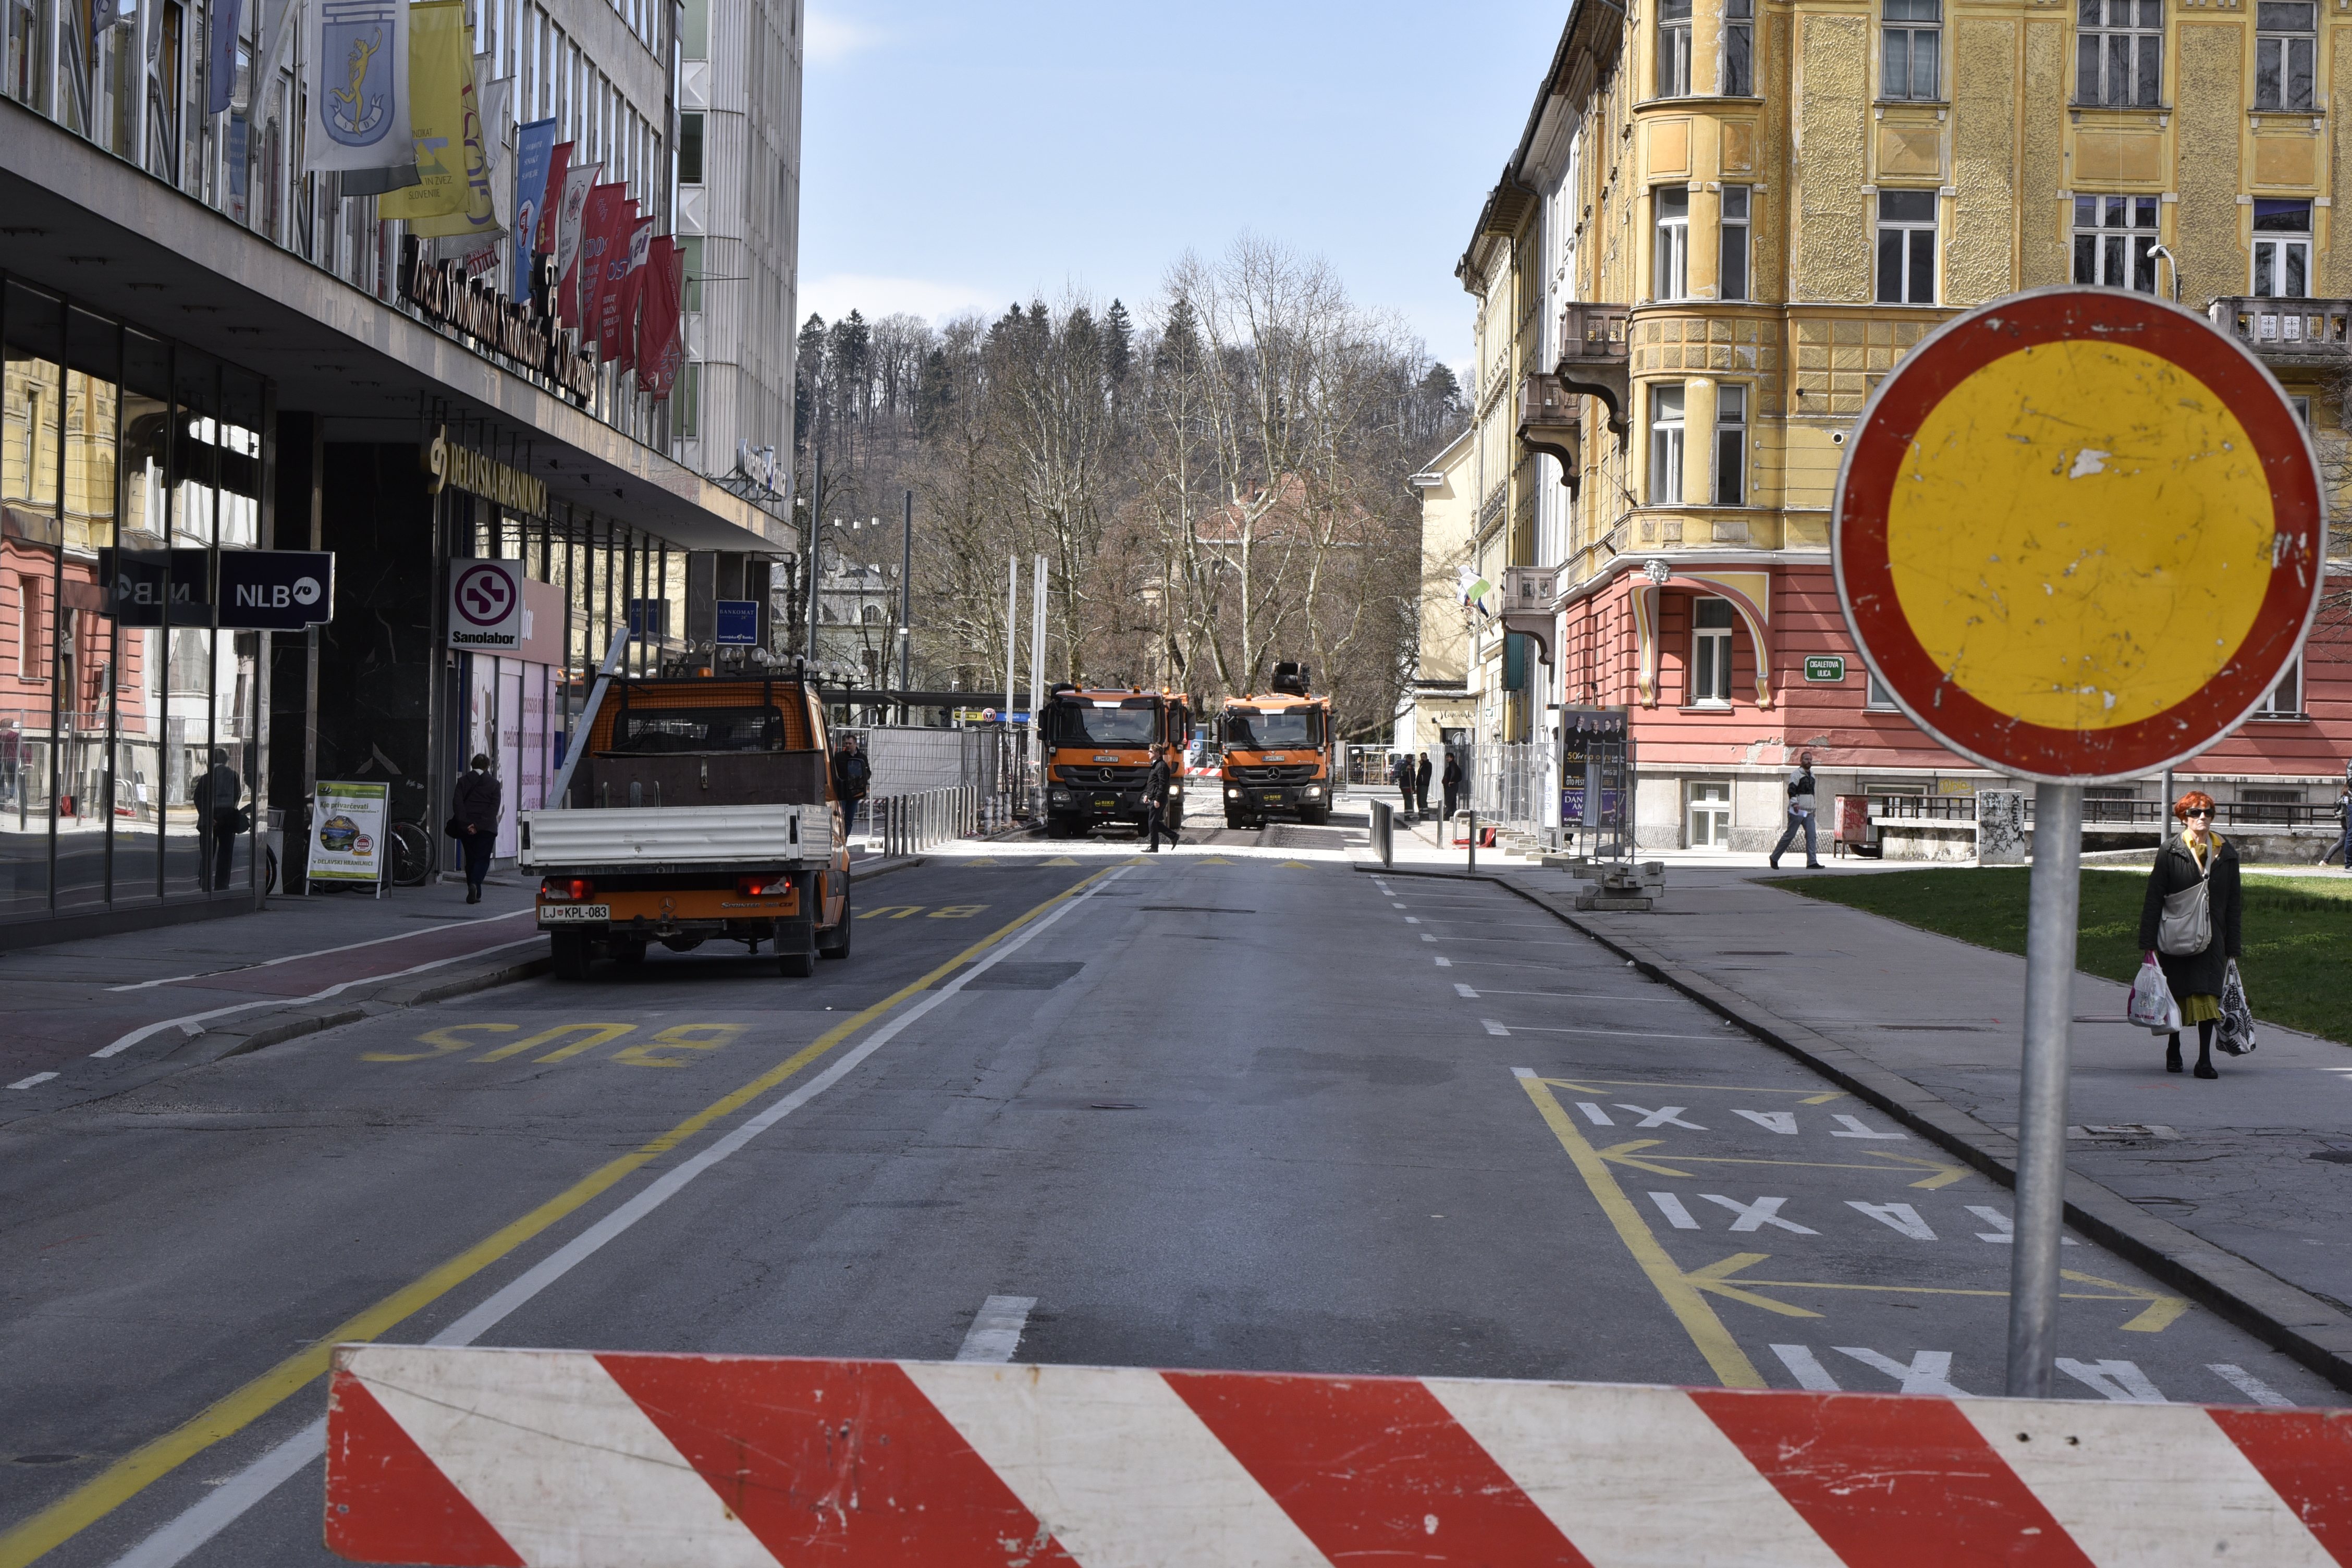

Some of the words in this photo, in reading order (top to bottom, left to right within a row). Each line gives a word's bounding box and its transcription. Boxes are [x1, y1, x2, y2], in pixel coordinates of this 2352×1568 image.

[412, 128, 433, 138] INDIKAT
[451, 442, 498, 503] DELAVSKA
[498, 462, 547, 520] HRANILNICA
[236, 584, 290, 608] NLB
[452, 631, 515, 644] Sanolabor
[331, 802, 369, 810] privarčevati
[543, 907, 556, 918] LJ
[564, 906, 607, 918] KPL-083
[1574, 1100, 1910, 1140] TAXI
